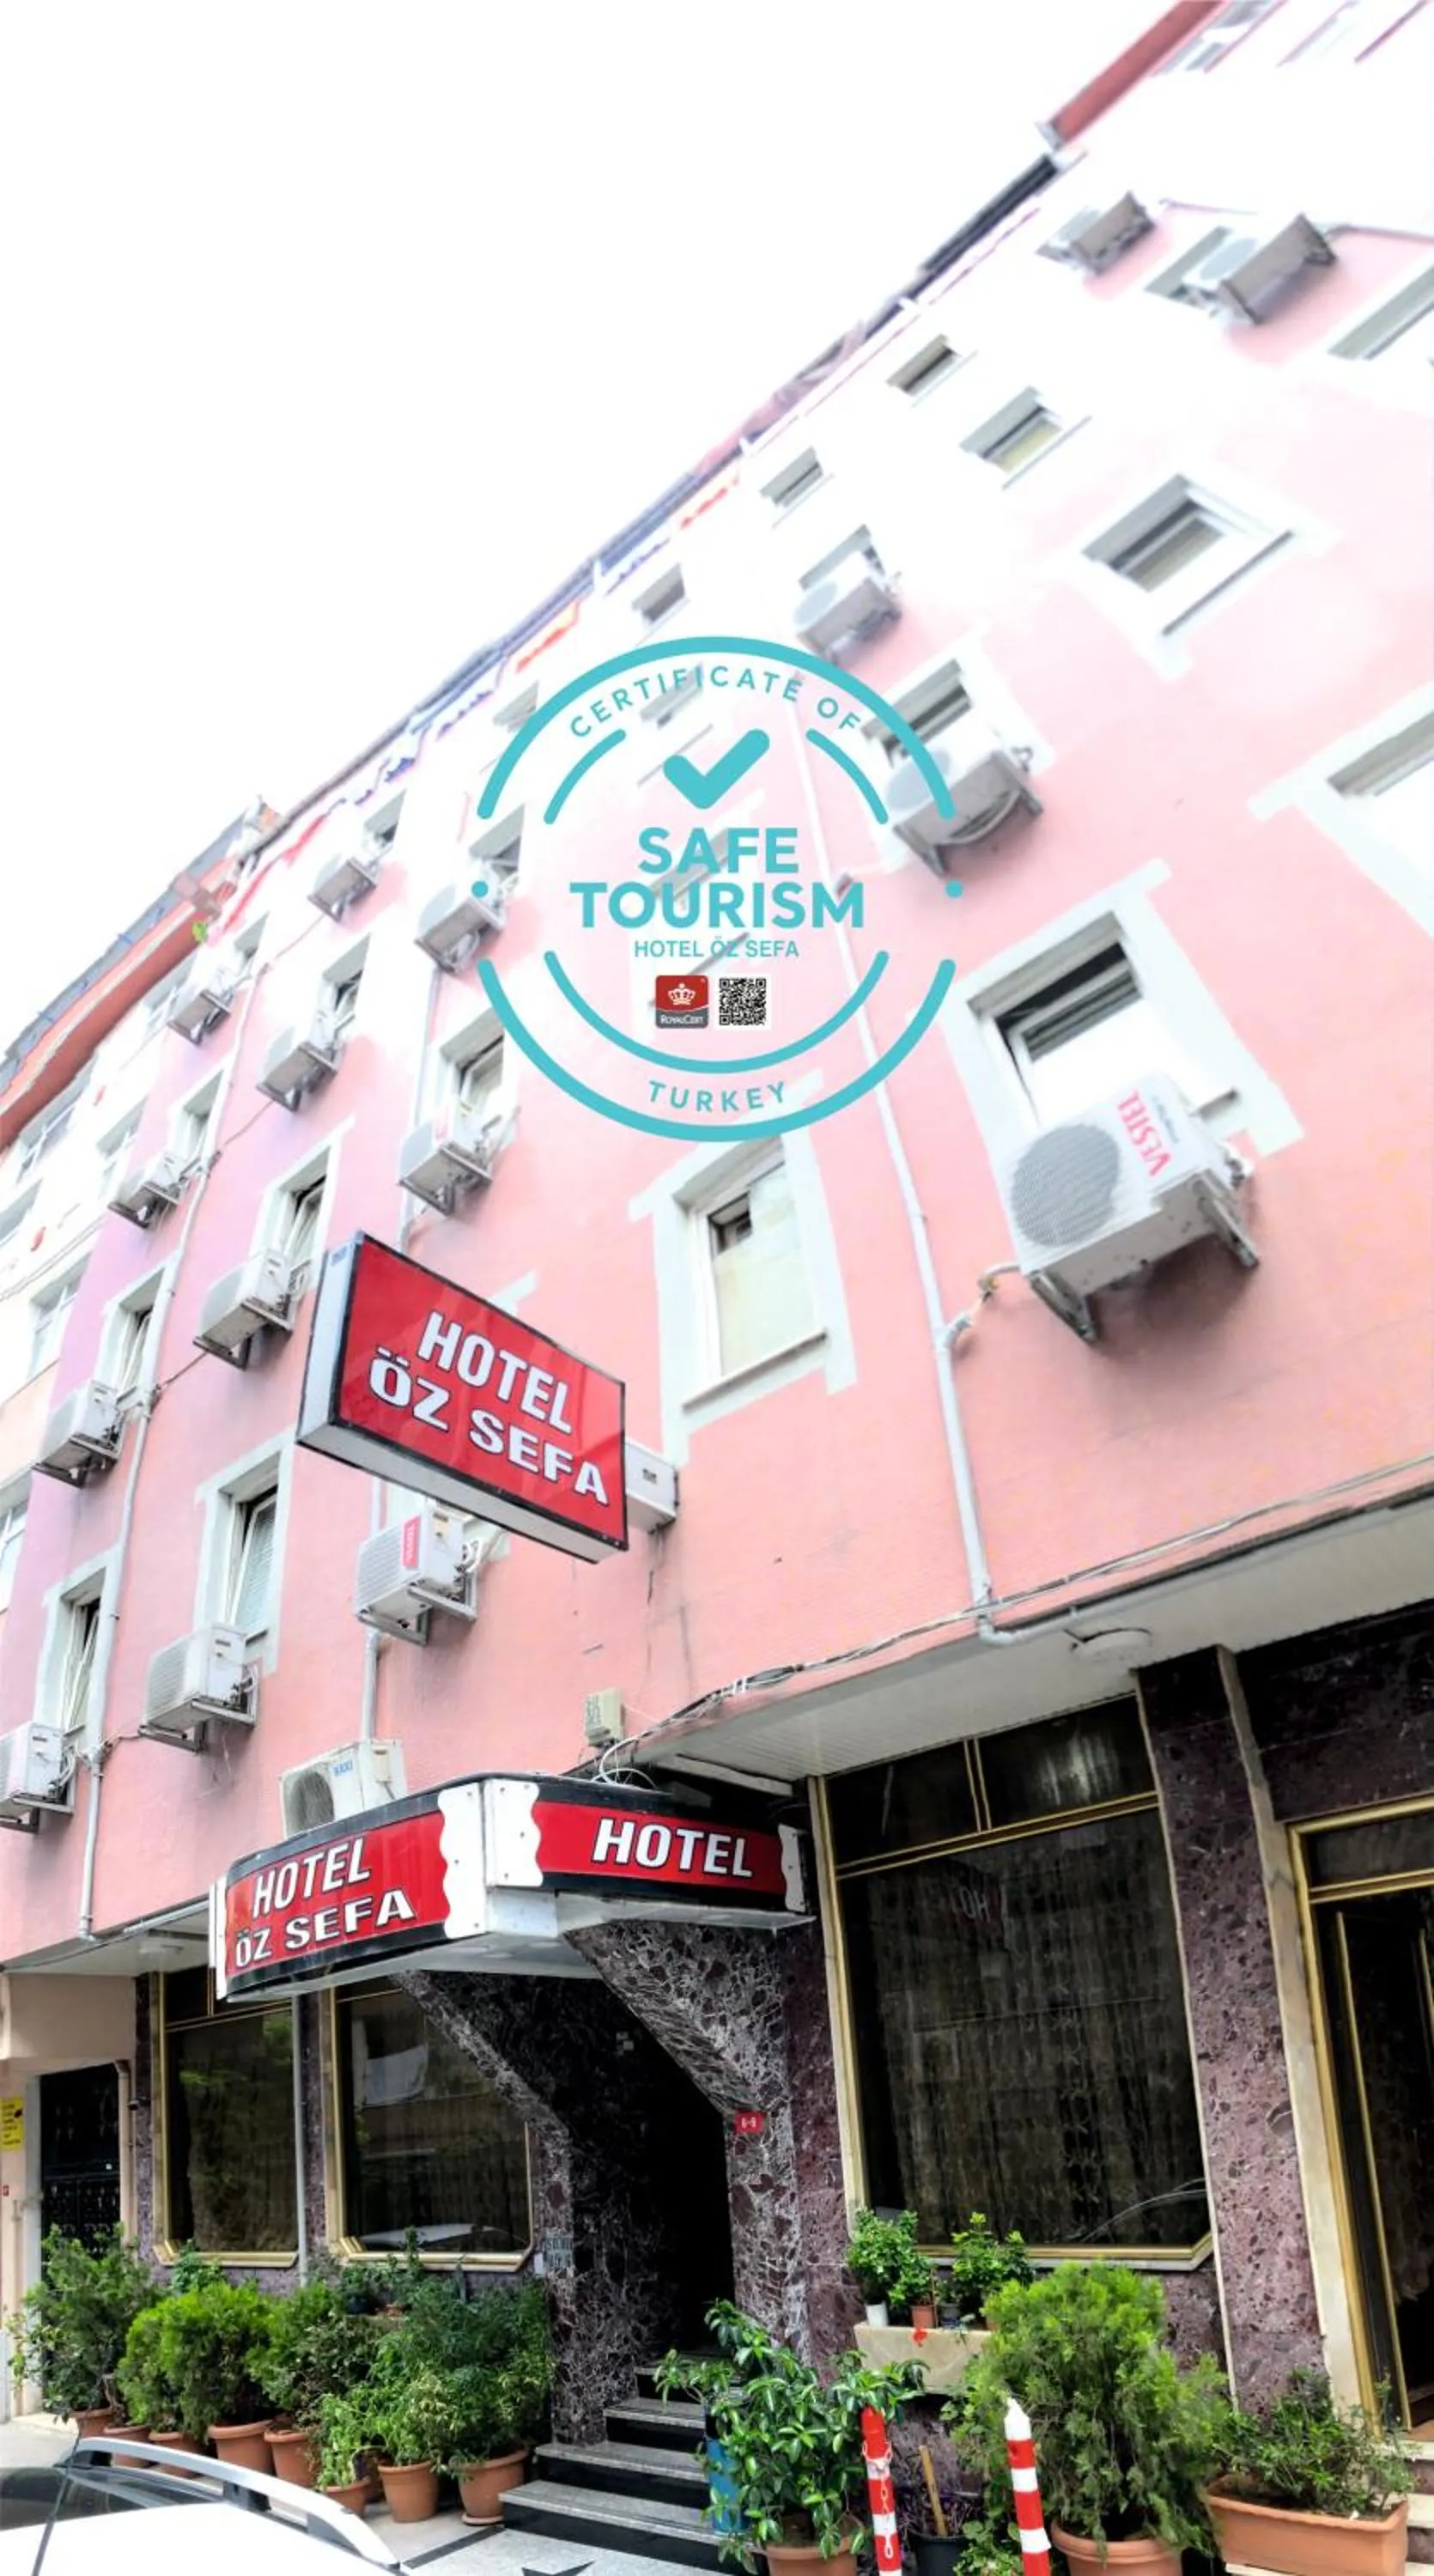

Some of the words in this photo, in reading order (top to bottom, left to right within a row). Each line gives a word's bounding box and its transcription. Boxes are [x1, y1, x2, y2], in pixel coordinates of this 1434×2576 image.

[1118, 1089, 1171, 1177] VESTEL
[417, 1310, 573, 1436] HOTEL
[368, 1346, 451, 1432] ÖZ
[469, 1408, 610, 1506] SEFA
[252, 1837, 371, 1919] HOTEL
[592, 1818, 753, 1878] HOTEL
[234, 1929, 272, 1968] ÖZ
[285, 1889, 416, 1950] SEFA
